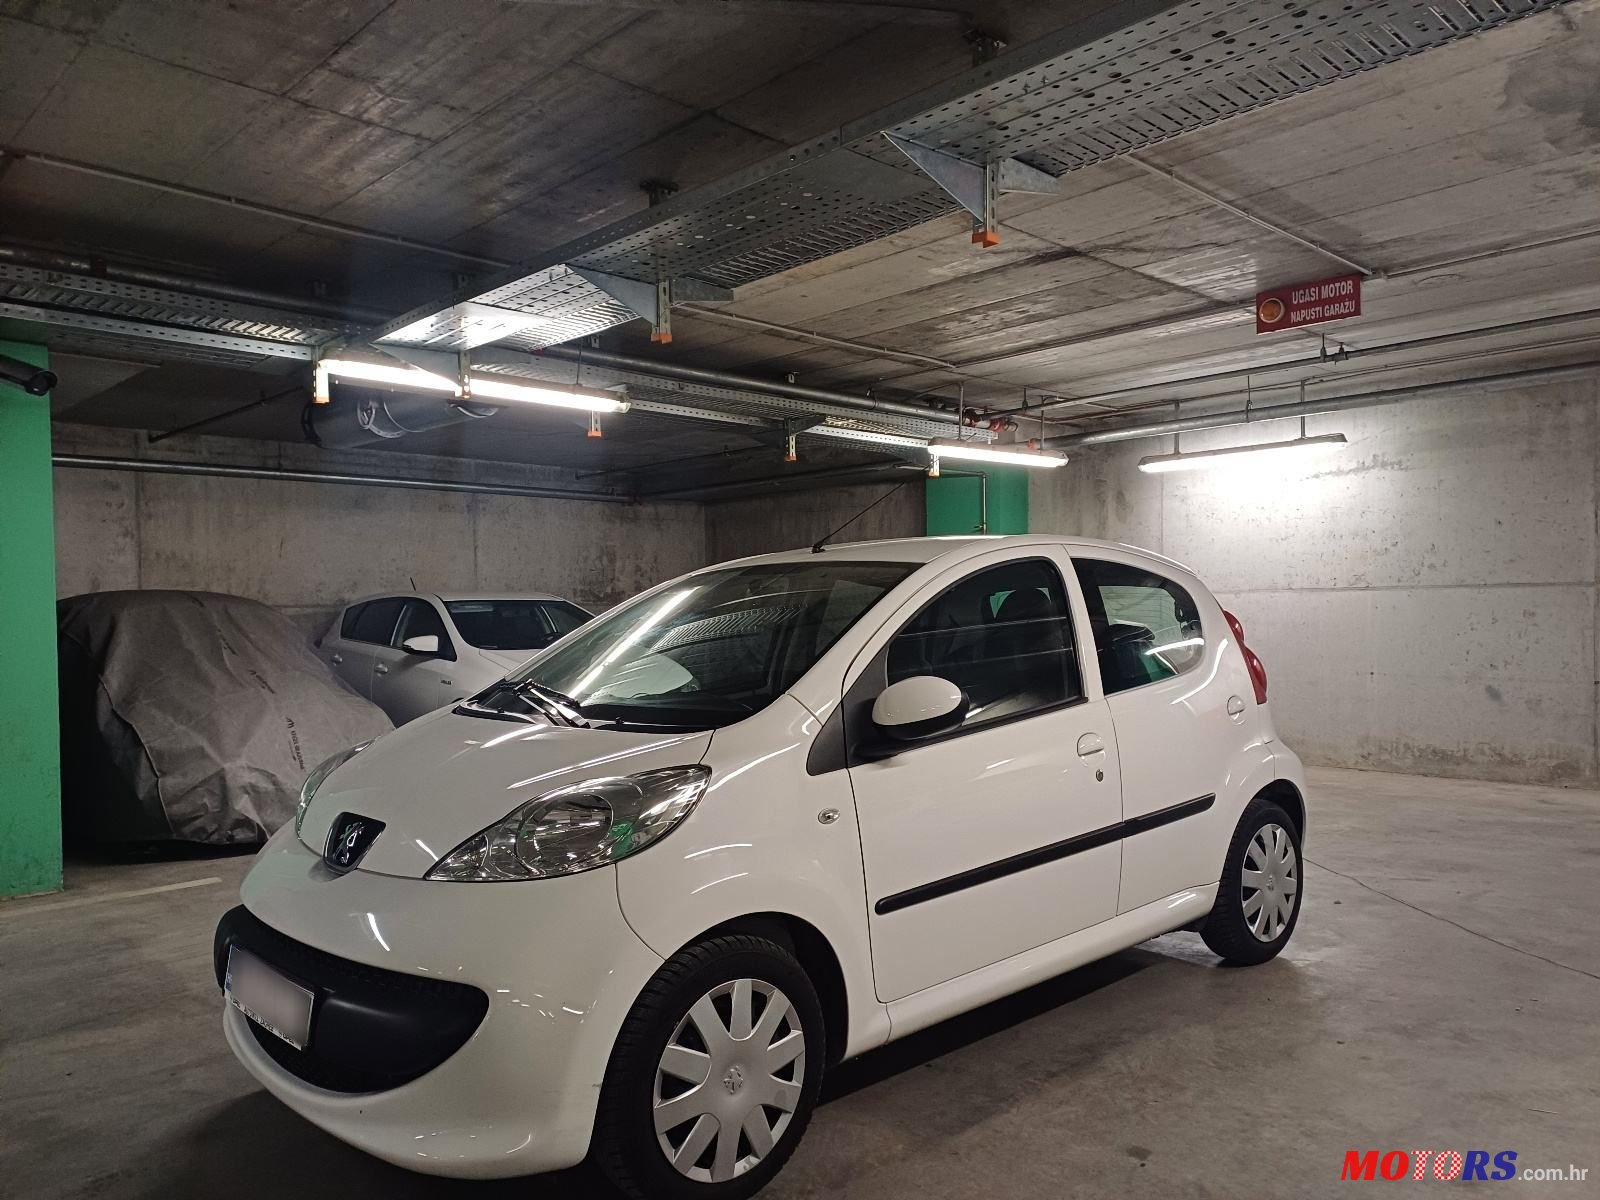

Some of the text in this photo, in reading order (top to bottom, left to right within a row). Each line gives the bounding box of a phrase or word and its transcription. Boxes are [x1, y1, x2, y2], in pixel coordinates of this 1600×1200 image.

[1292, 280, 1353, 305] UGASI MOTOR
[1290, 298, 1355, 323] NAPUSTI GARAŽU
